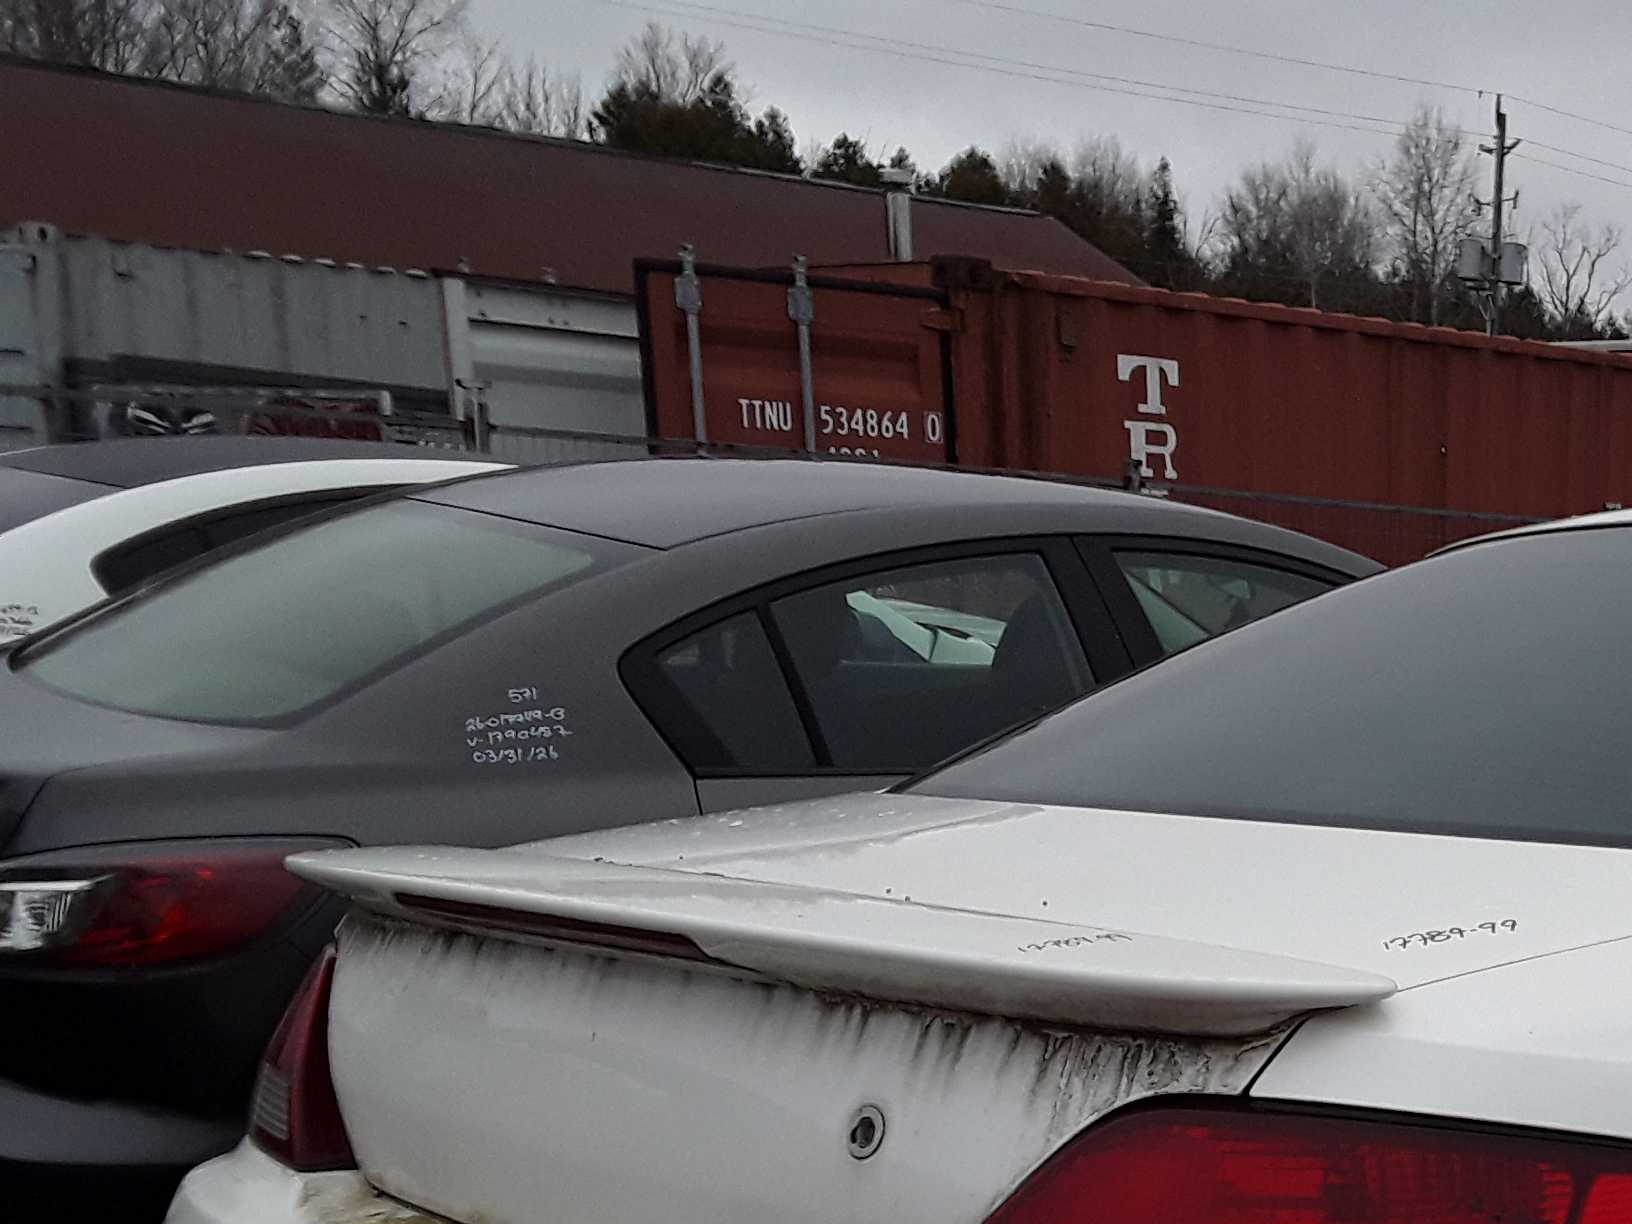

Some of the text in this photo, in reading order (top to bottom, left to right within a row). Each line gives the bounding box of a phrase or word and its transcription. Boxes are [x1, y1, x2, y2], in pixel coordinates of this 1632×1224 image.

[738, 398, 793, 432] TTNU
[819, 404, 910, 440] 534864
[1116, 353, 1180, 496] TR
[1382, 919, 1518, 951] 17789-99
